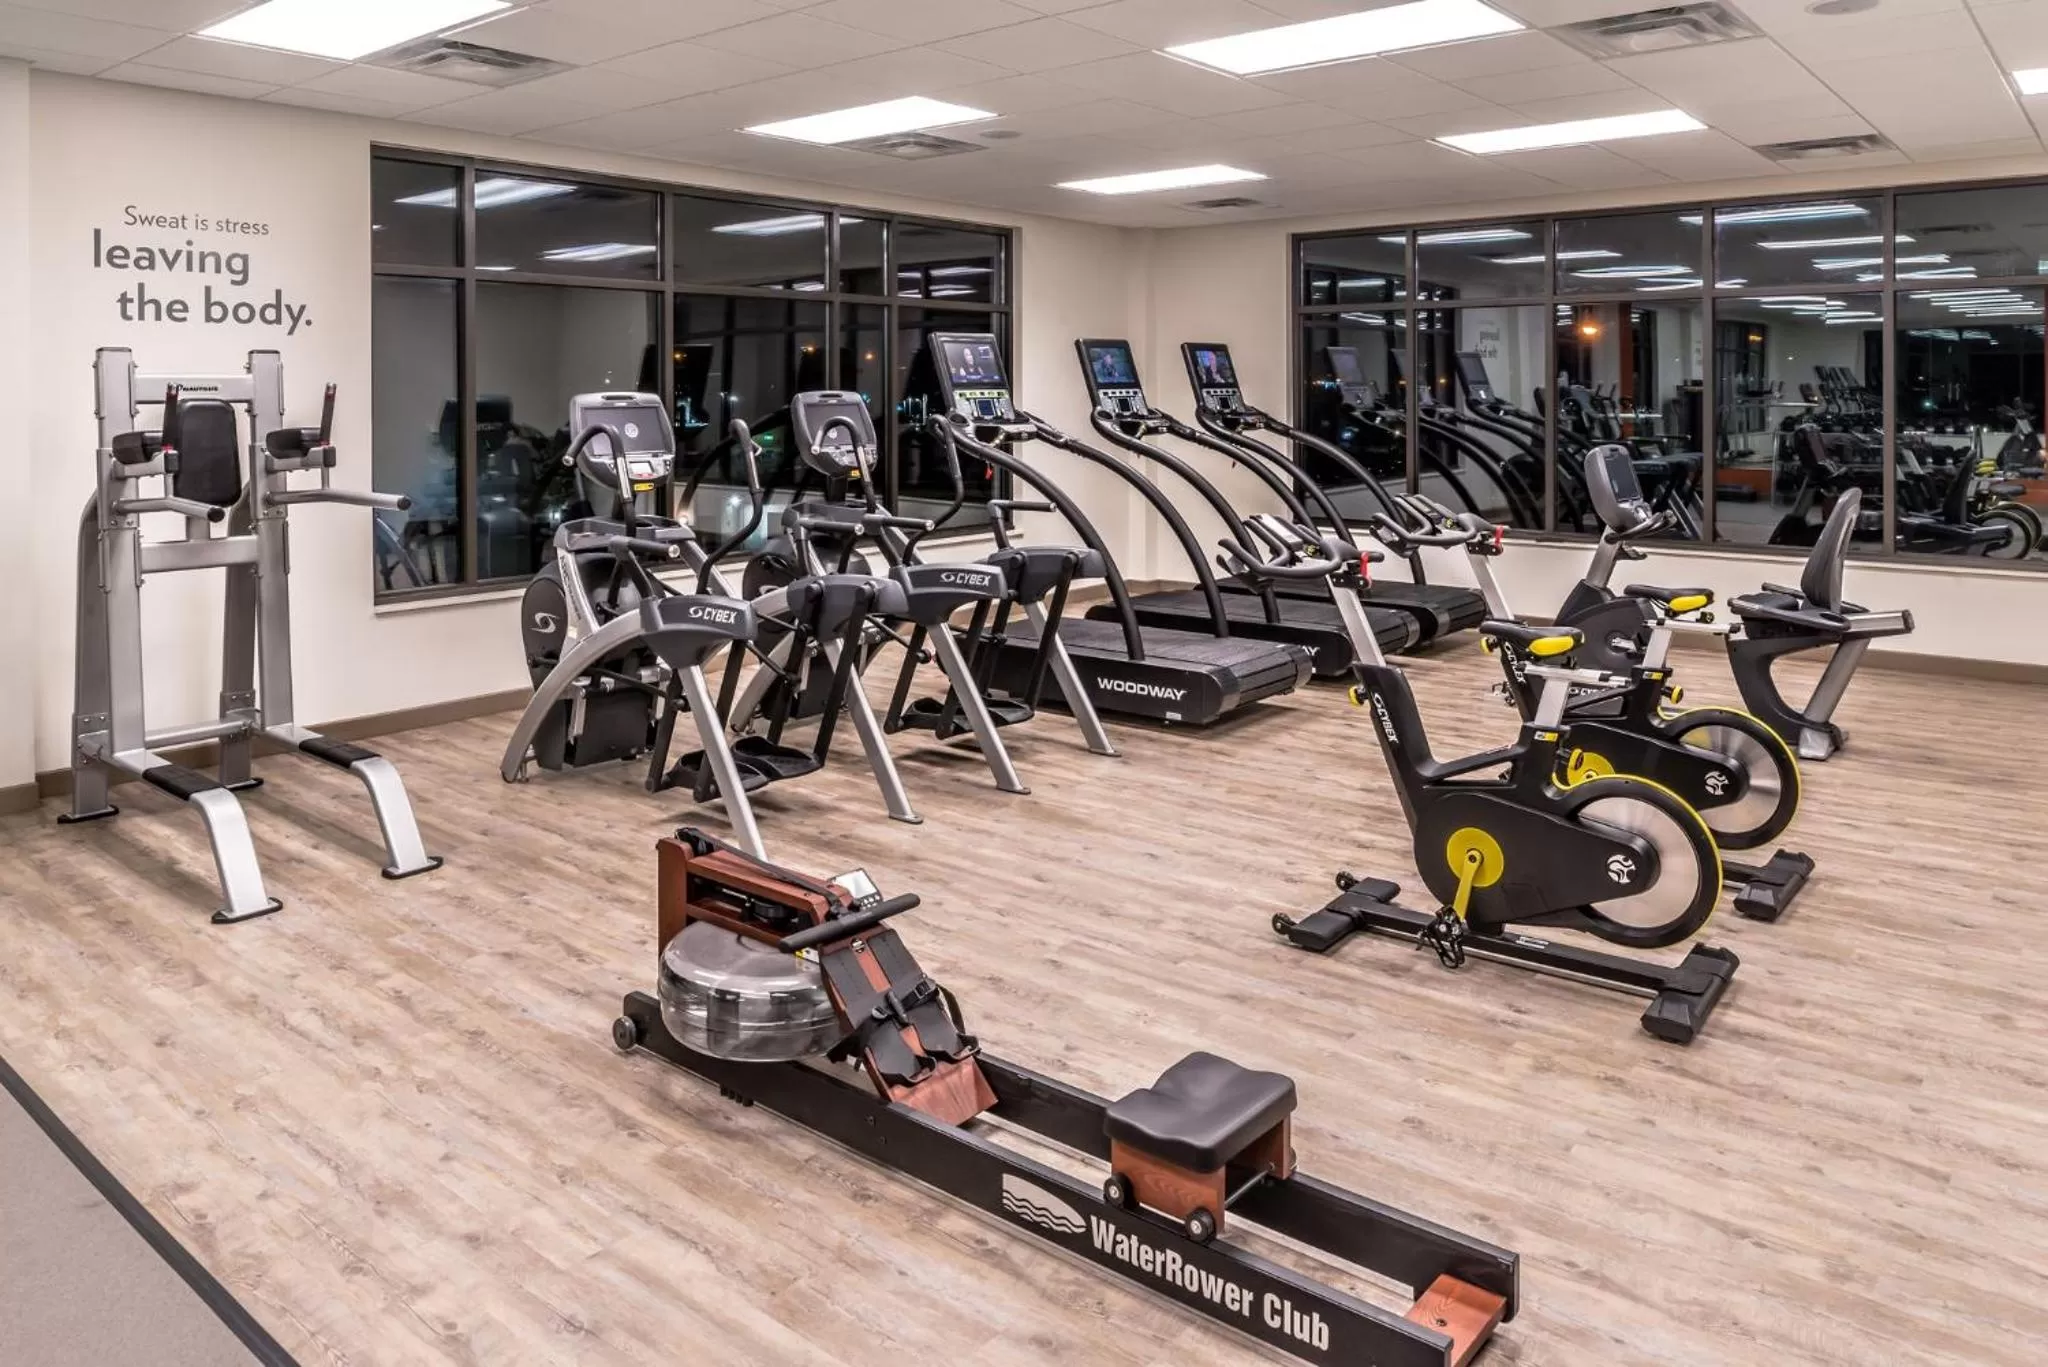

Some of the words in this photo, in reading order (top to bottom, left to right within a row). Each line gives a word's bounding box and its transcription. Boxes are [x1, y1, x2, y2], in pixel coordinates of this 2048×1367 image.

[124, 205, 188, 230] Sweat
[194, 214, 209, 231] is
[215, 217, 270, 236] stress
[93, 228, 250, 286] leaving
[116, 282, 190, 323] the
[204, 285, 313, 336] body.
[956, 572, 991, 587] CYBEX
[703, 607, 738, 624] CYBEX
[1097, 677, 1187, 701] WOODWAY
[1377, 708, 1399, 743] CYBEX
[1090, 1214, 1254, 1317] WaterRower
[1262, 1292, 1330, 1352] Club
